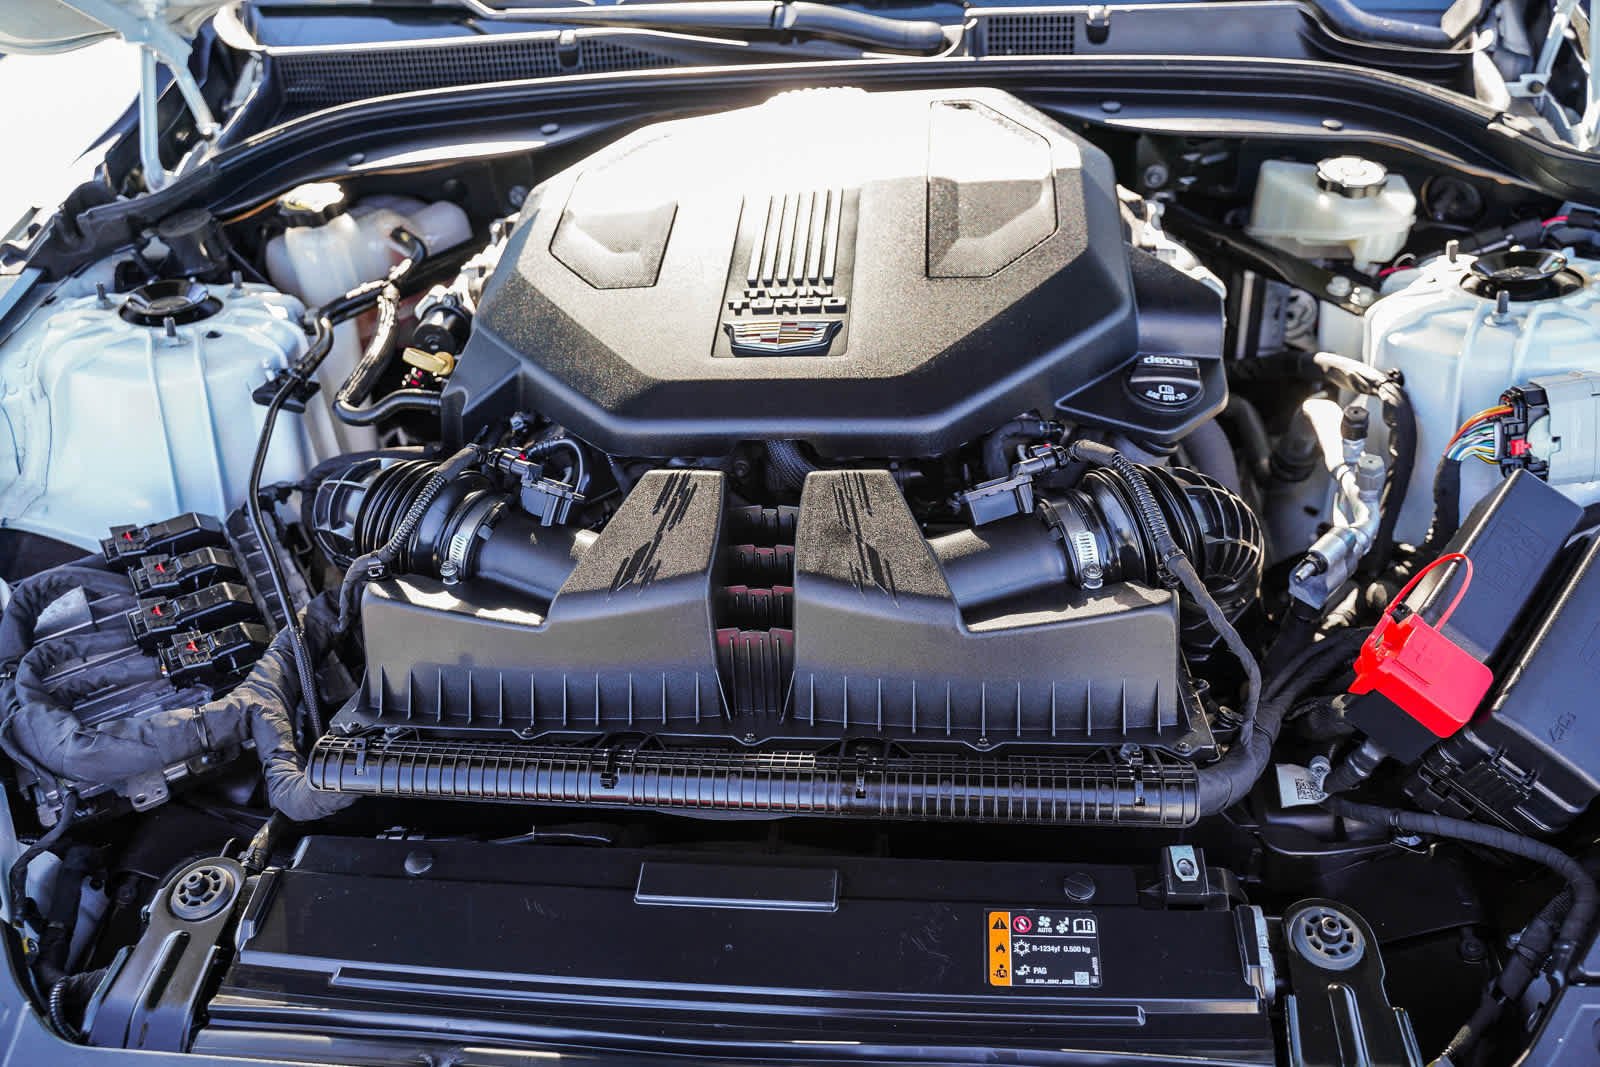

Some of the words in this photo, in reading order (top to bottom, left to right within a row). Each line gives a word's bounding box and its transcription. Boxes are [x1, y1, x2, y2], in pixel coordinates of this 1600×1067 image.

[743, 287, 834, 298] TWIN
[728, 297, 847, 315] TURBO
[1032, 945, 1061, 953] R-1234yf
[1082, 945, 1091, 954] kg
